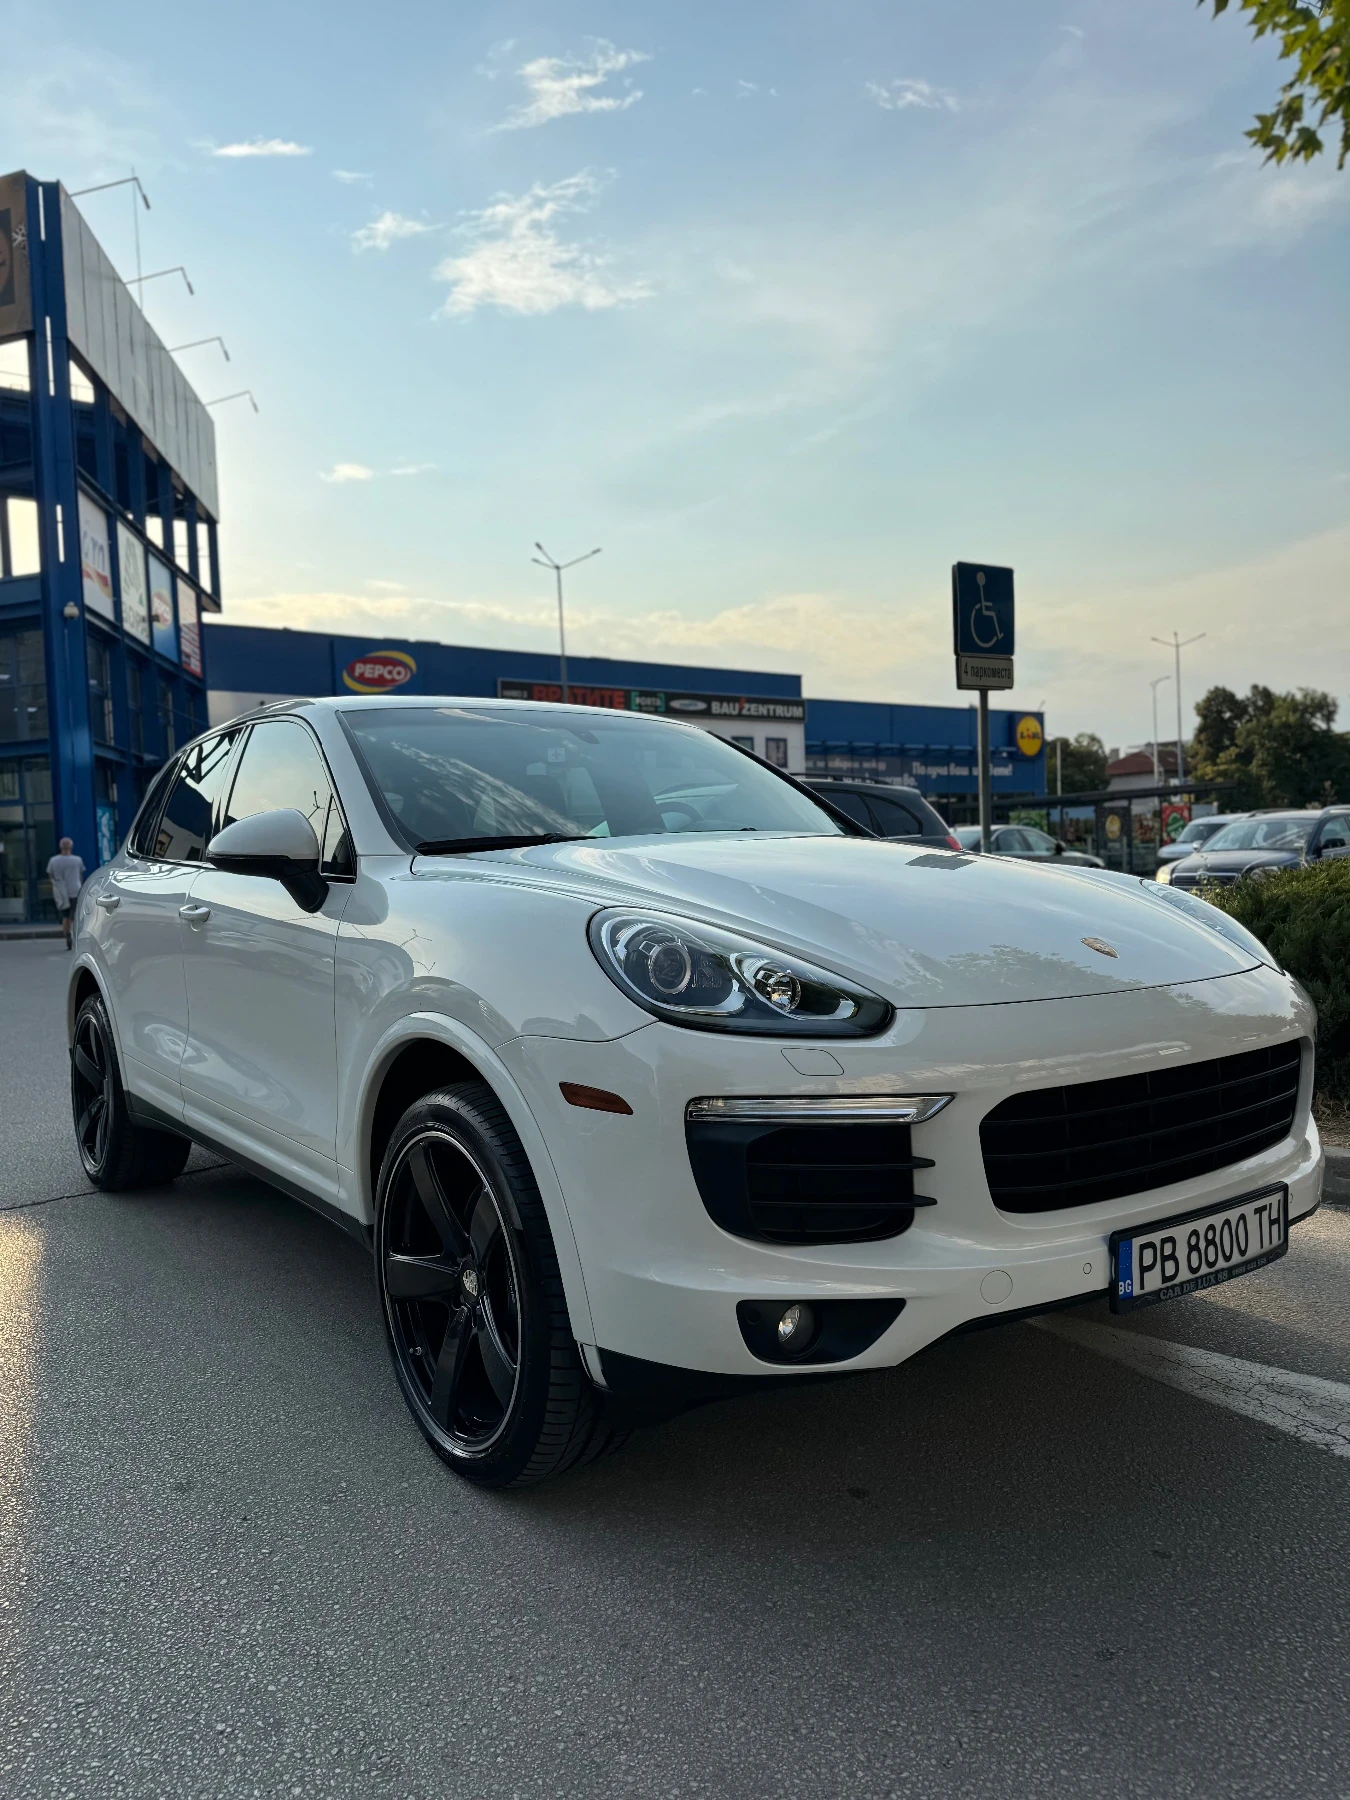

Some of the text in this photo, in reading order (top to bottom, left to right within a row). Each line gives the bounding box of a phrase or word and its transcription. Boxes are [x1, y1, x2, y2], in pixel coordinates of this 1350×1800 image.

[354, 663, 406, 680] PEPCO
[963, 661, 1012, 681] 4 паркоместа
[741, 703, 803, 718] ZENTRUM
[1139, 1198, 1282, 1291] PB 8800 TH
[1118, 1279, 1132, 1295] BG
[1160, 1270, 1228, 1300] CAR DE LUX 88
